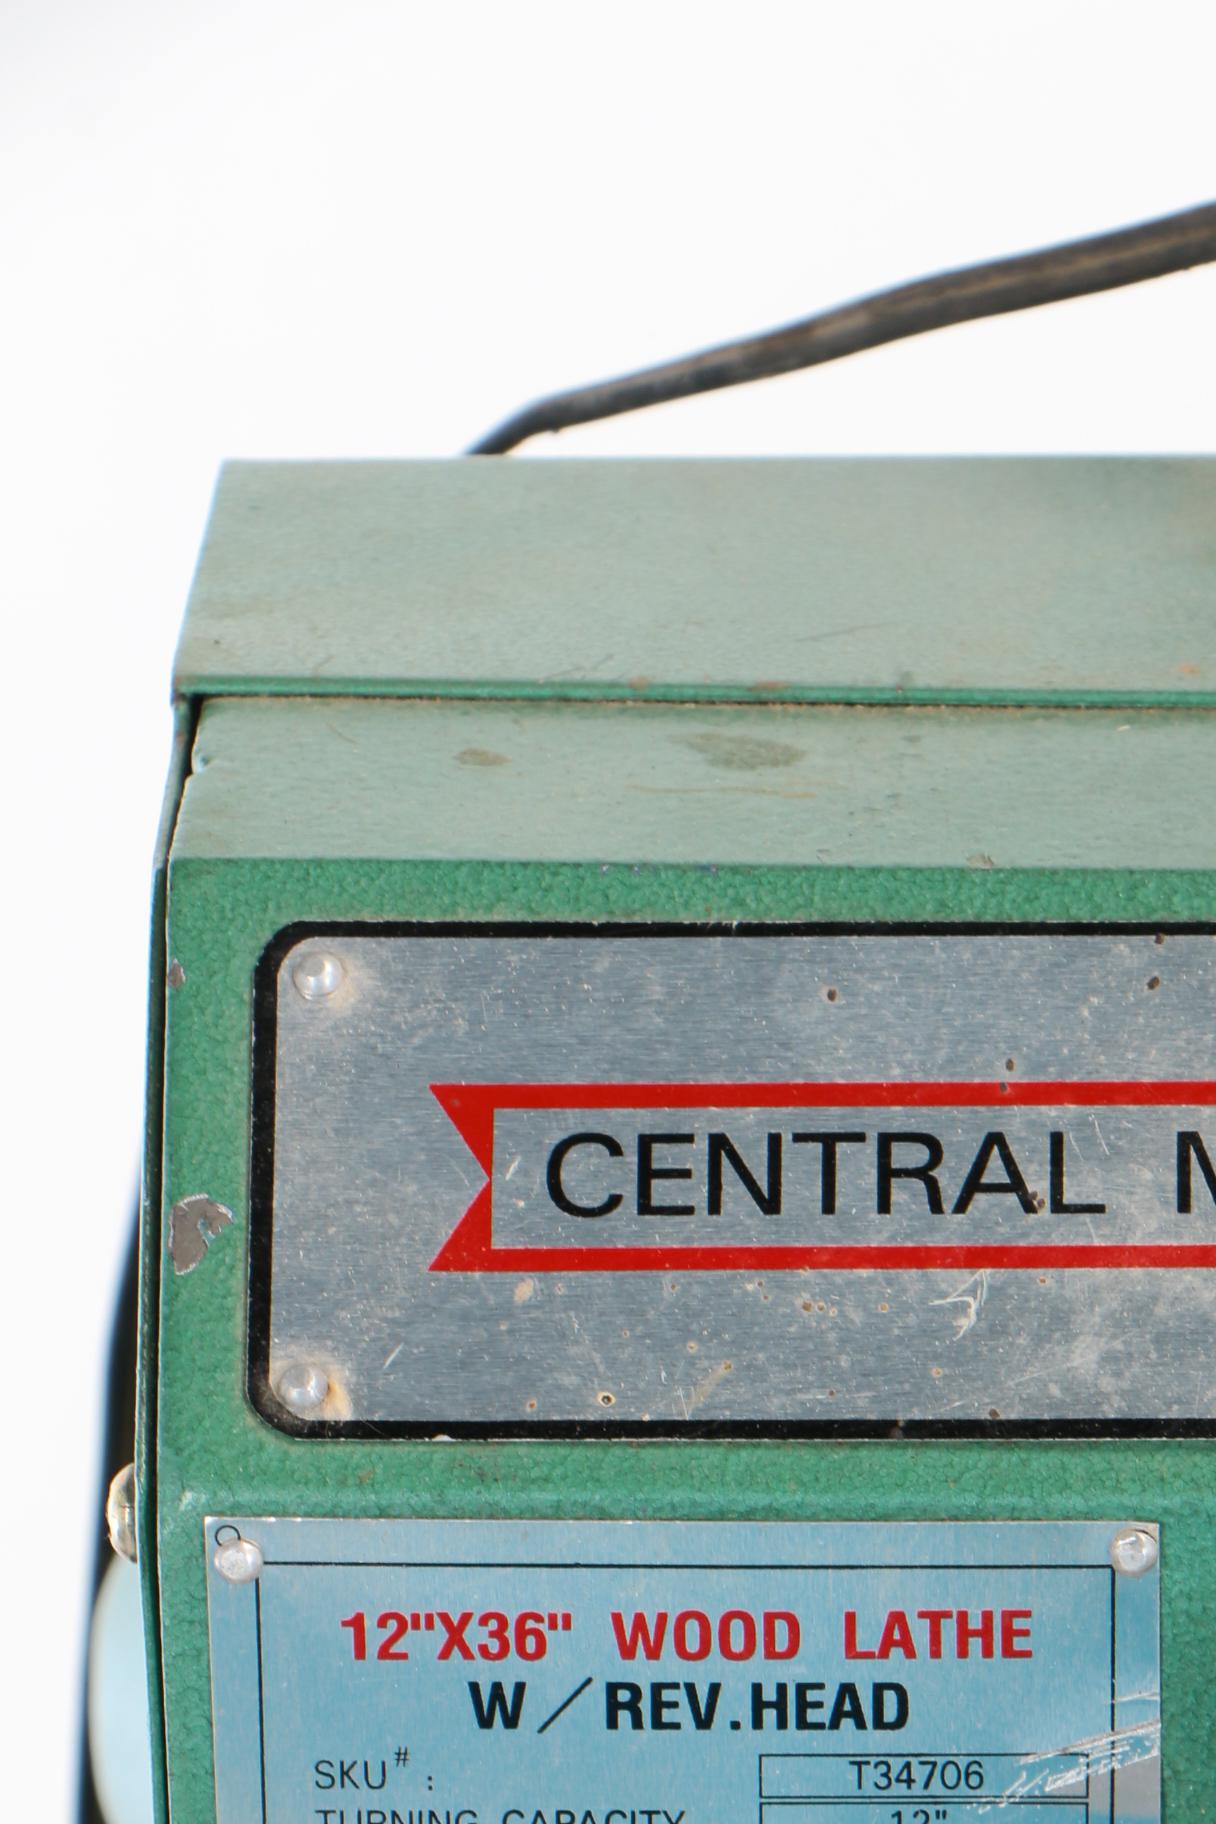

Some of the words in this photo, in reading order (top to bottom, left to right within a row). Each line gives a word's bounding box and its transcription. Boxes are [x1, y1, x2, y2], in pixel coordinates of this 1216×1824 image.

[546, 1131, 1106, 1219] CENTRAL
[340, 1610, 572, 1661] 12"X36"
[610, 1608, 801, 1661] WOOD
[844, 1608, 1033, 1660] LATHE
[848, 1759, 984, 1791] T34706
